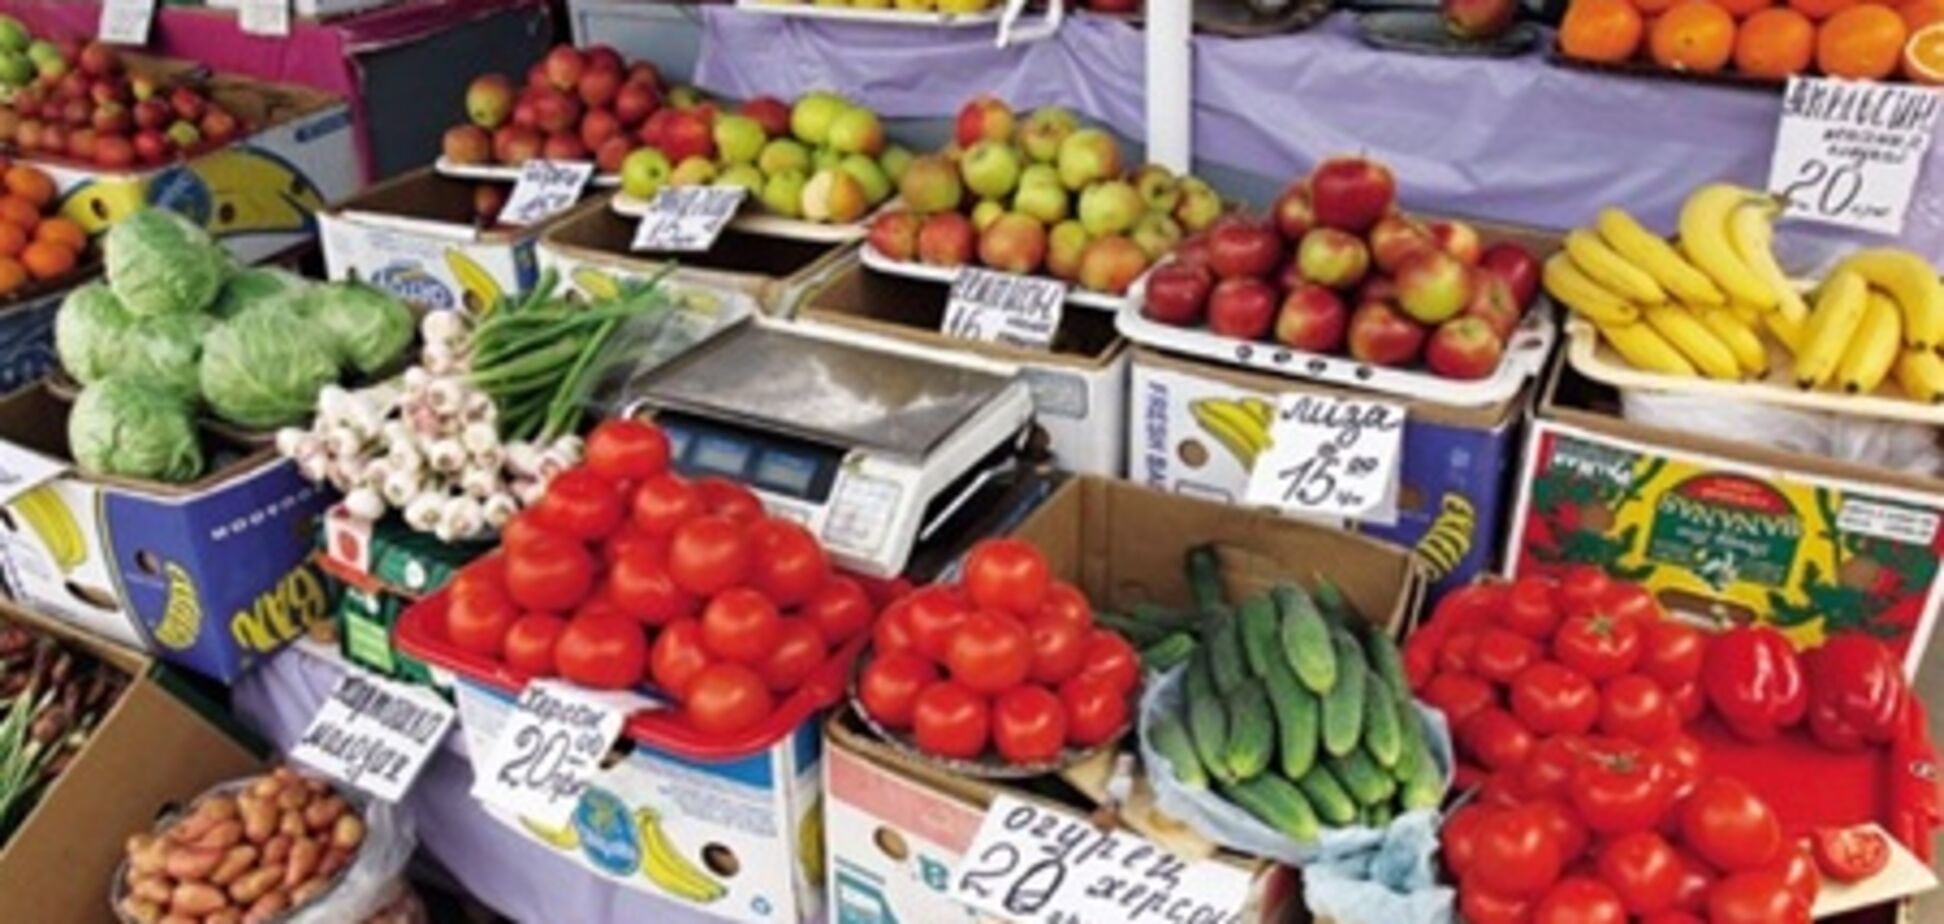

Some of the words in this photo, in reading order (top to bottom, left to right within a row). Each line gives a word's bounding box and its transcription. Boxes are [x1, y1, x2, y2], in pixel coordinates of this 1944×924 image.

[1784, 158, 1863, 217] 20
[1278, 450, 1340, 505] 15
[1659, 491, 1802, 538] BANANAS
[498, 725, 570, 788] 20
[959, 842, 1068, 913] 20
